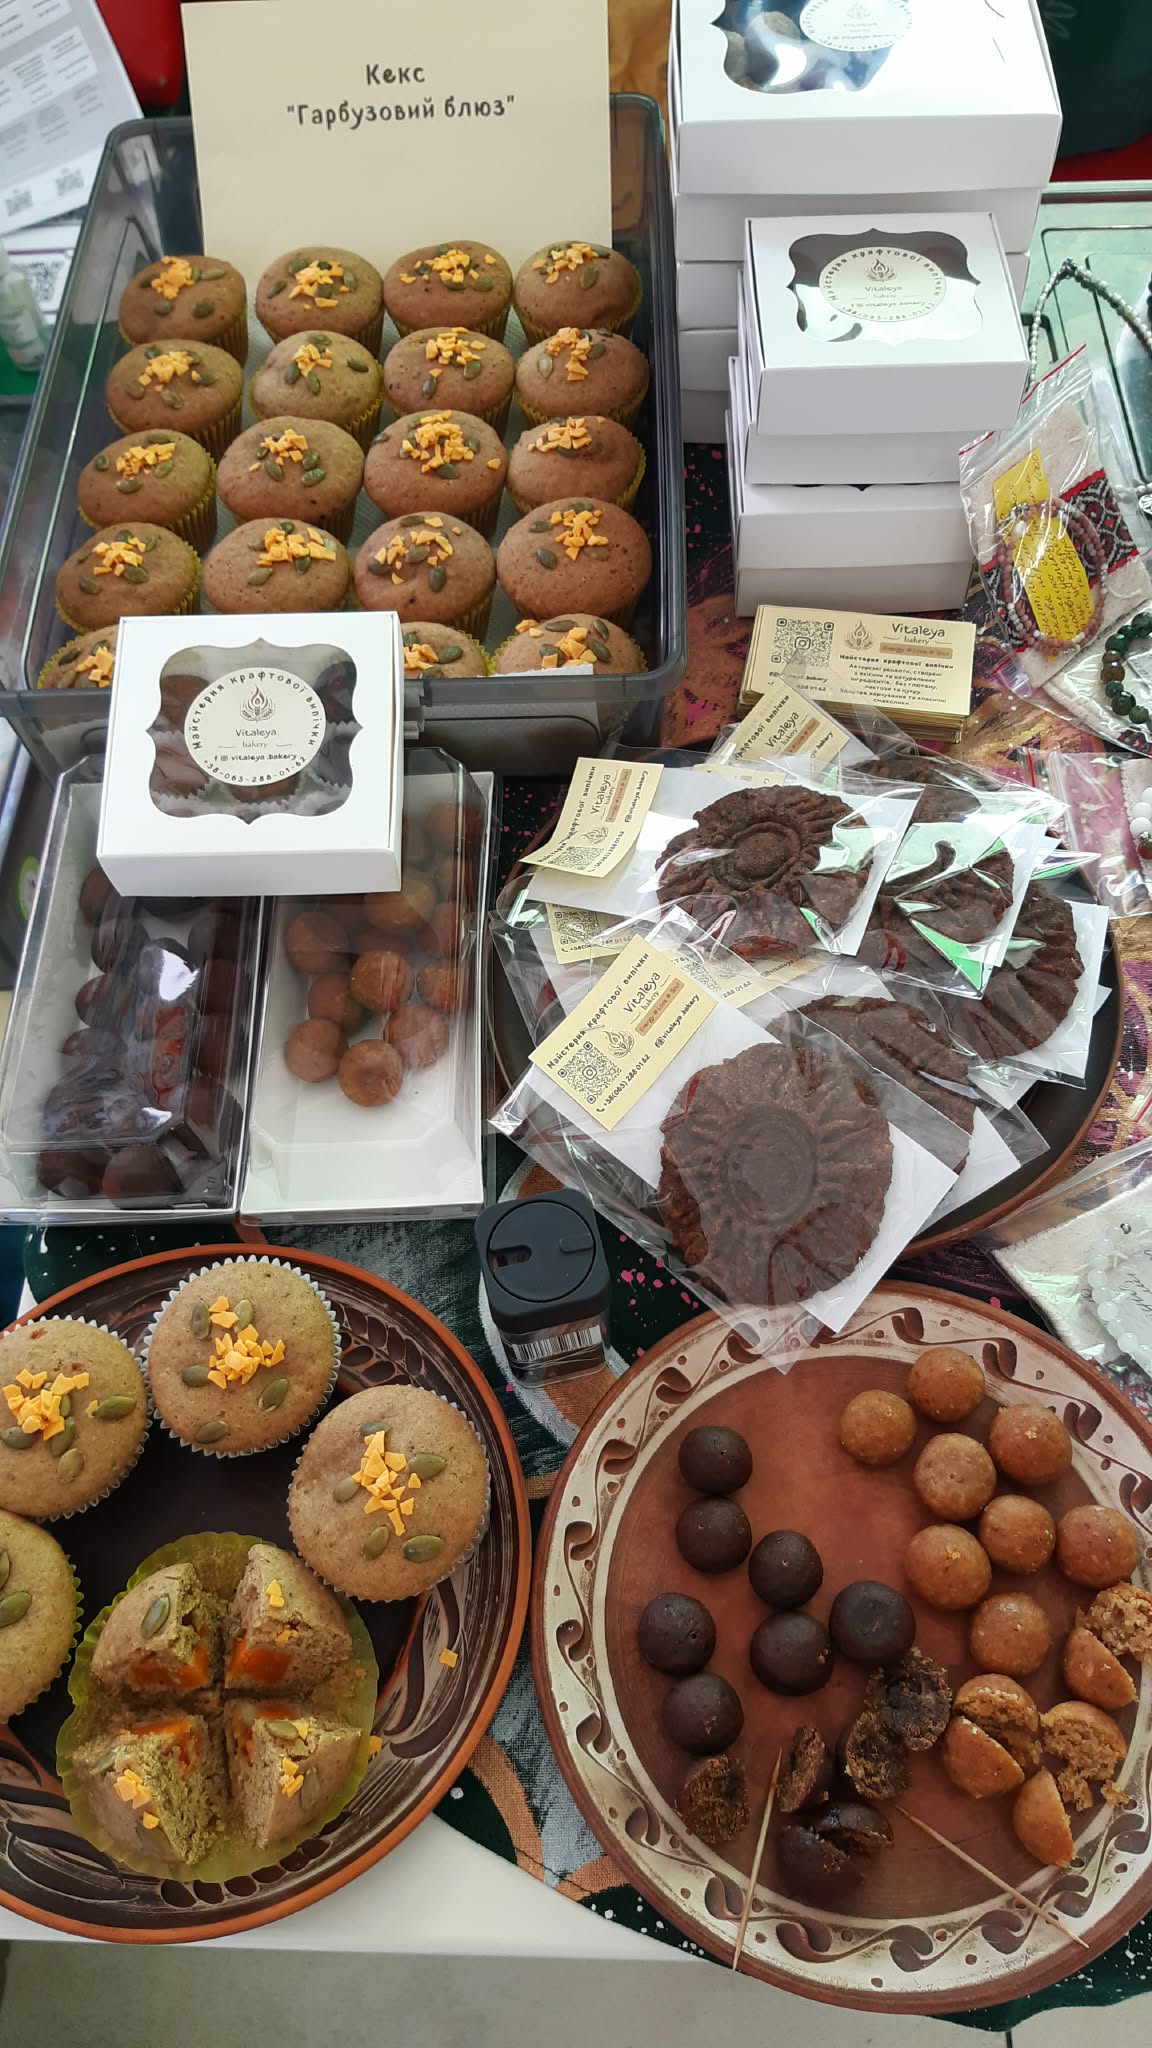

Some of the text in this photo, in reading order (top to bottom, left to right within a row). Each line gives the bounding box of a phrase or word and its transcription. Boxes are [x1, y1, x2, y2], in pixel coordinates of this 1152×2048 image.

[366, 64, 426, 85] Кекс
[287, 95, 514, 131] "Гарбузовий блюз"
[891, 623, 946, 640] Vitaleya
[904, 636, 930, 645] bakery
[190, 671, 320, 750] Майстерня крафтової випічки
[766, 696, 789, 722] випічки
[235, 728, 277, 737] Vitaleya
[766, 712, 798, 746] Vitaleya
[590, 774, 611, 816] Vitaleya
[624, 973, 660, 1012] Vitaleya
[640, 988, 659, 1010] bakery
[547, 954, 648, 1068] Майстерня крафтової випічки
